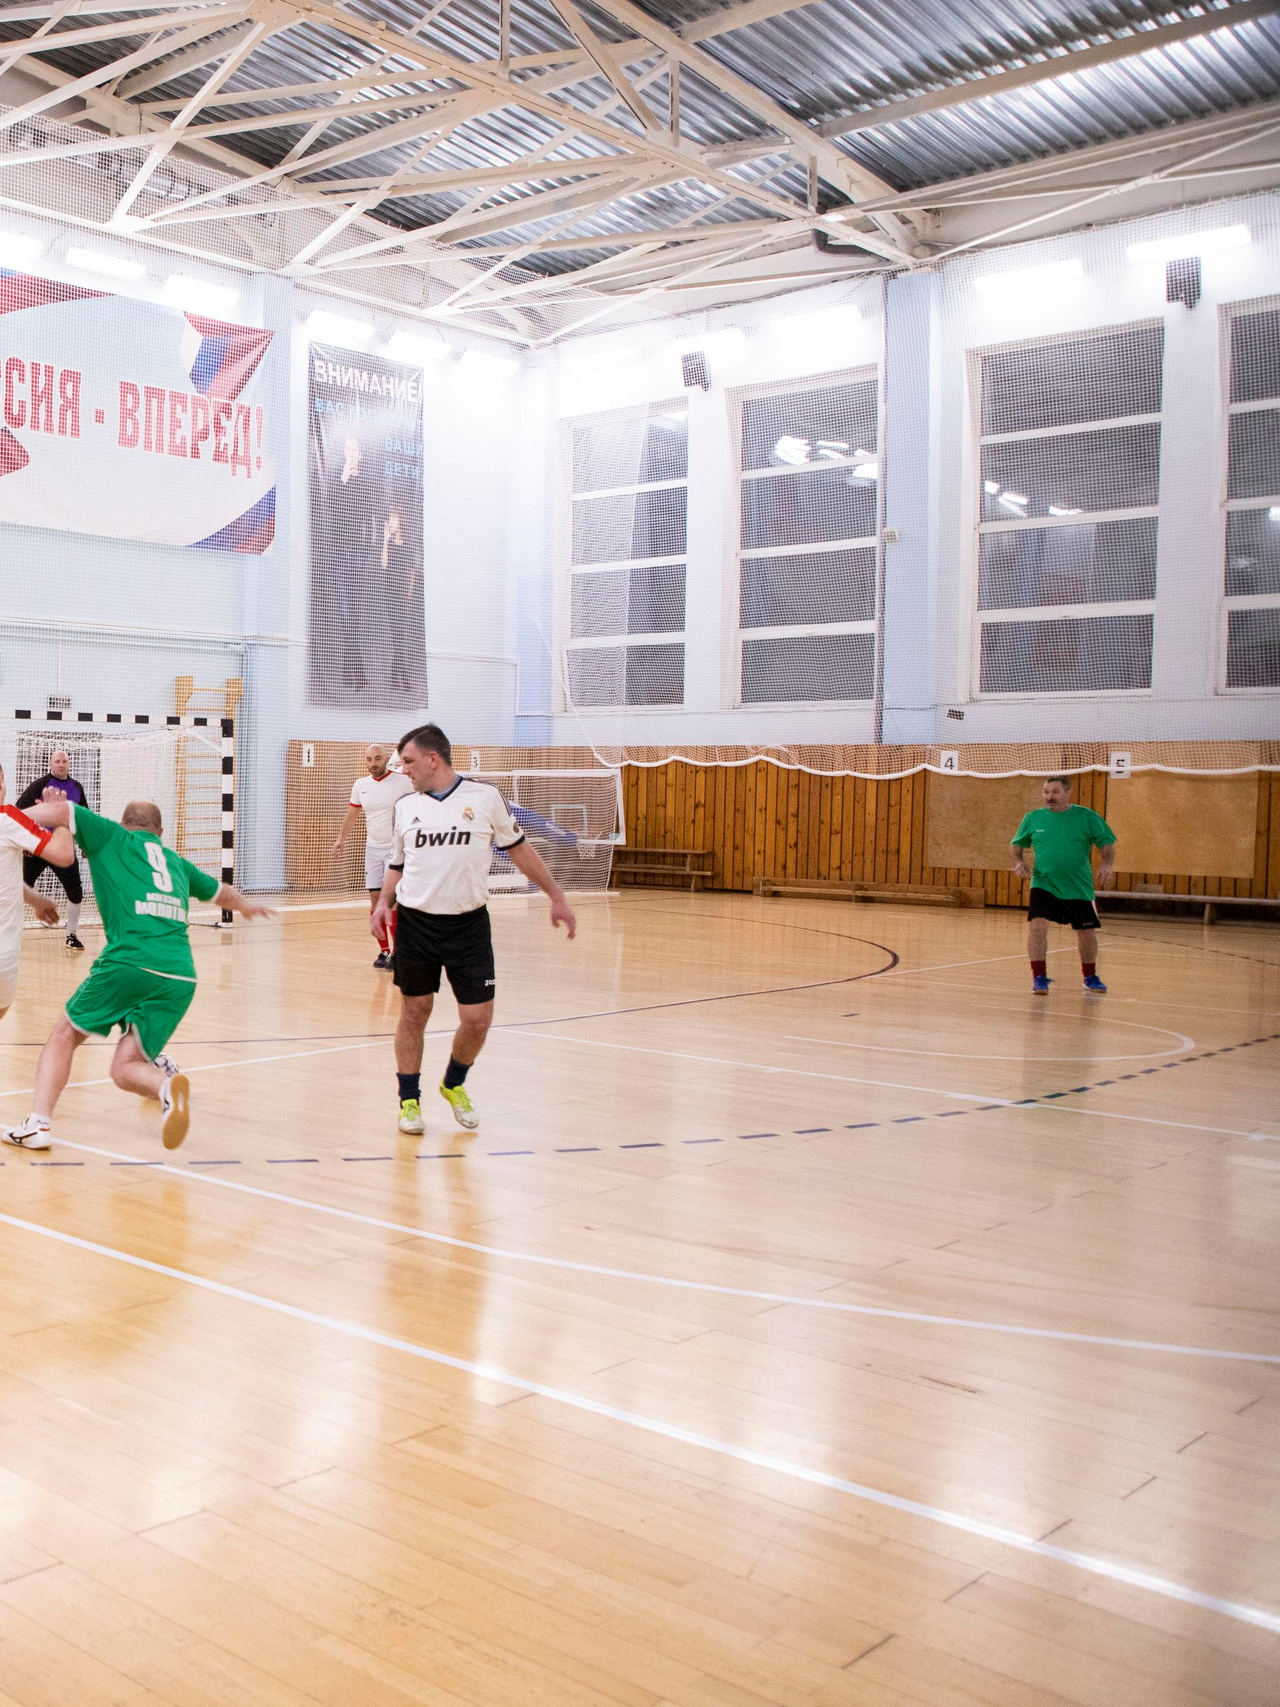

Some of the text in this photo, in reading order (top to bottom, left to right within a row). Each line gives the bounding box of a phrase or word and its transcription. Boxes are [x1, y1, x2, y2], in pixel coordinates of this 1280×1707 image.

[117, 380, 265, 480] ВПЕРЕД!
[944, 756, 955, 770] 4
[1115, 758, 1125, 774] 5
[414, 825, 471, 849] bwin
[144, 841, 173, 893] 9
